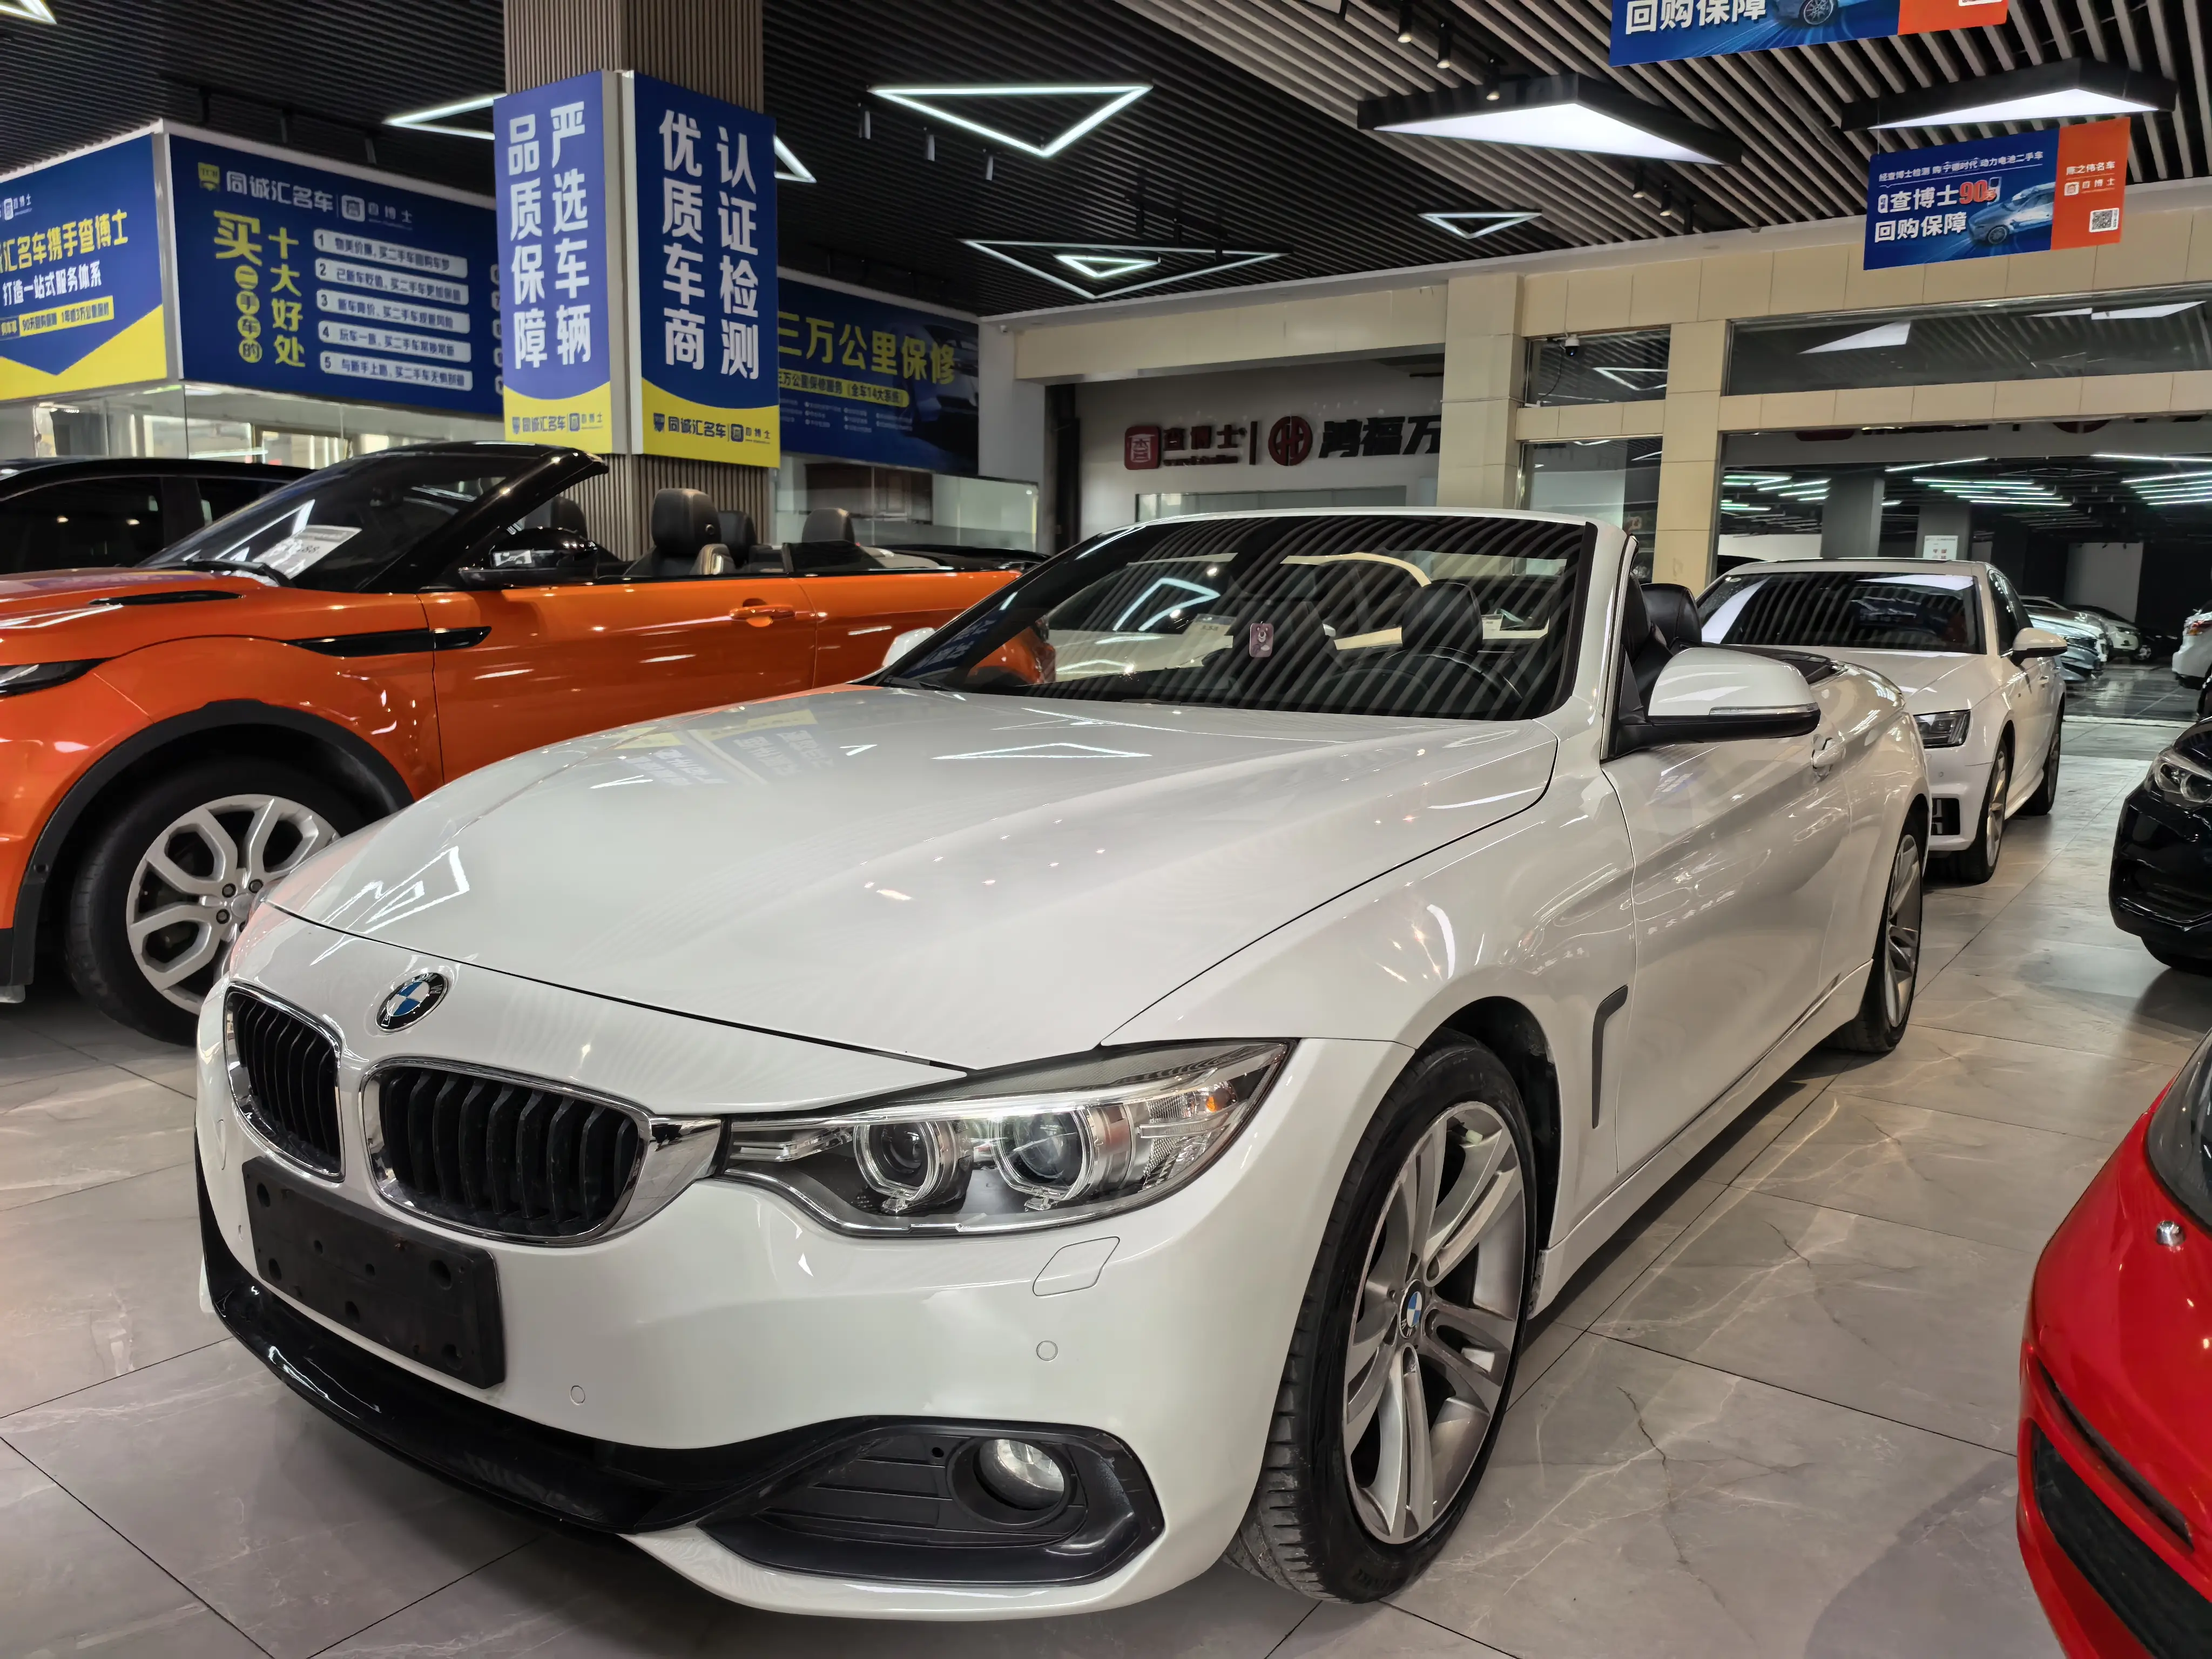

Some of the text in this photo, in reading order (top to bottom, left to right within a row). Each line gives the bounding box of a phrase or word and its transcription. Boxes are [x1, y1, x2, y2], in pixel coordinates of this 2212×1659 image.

[1626, 0, 1766, 35] 回购保障
[226, 171, 333, 212] 同诚汇名车
[0, 209, 129, 273] 汇名车携手查博士
[508, 114, 548, 369] 品质保障
[550, 101, 591, 366] 严选车辆
[659, 109, 705, 370] 优质车商
[1875, 211, 1967, 243] 回购保障
[320, 263, 326, 276] 2
[716, 126, 759, 379] 认证检测
[2, 260, 102, 306] 打造一站式服务体系
[268, 227, 305, 368] 十大好处
[321, 294, 328, 307] 3
[322, 325, 329, 338] 4
[778, 311, 955, 385] 三万公里保修
[325, 356, 331, 369] 5
[668, 416, 726, 439] 同诚汇名车
